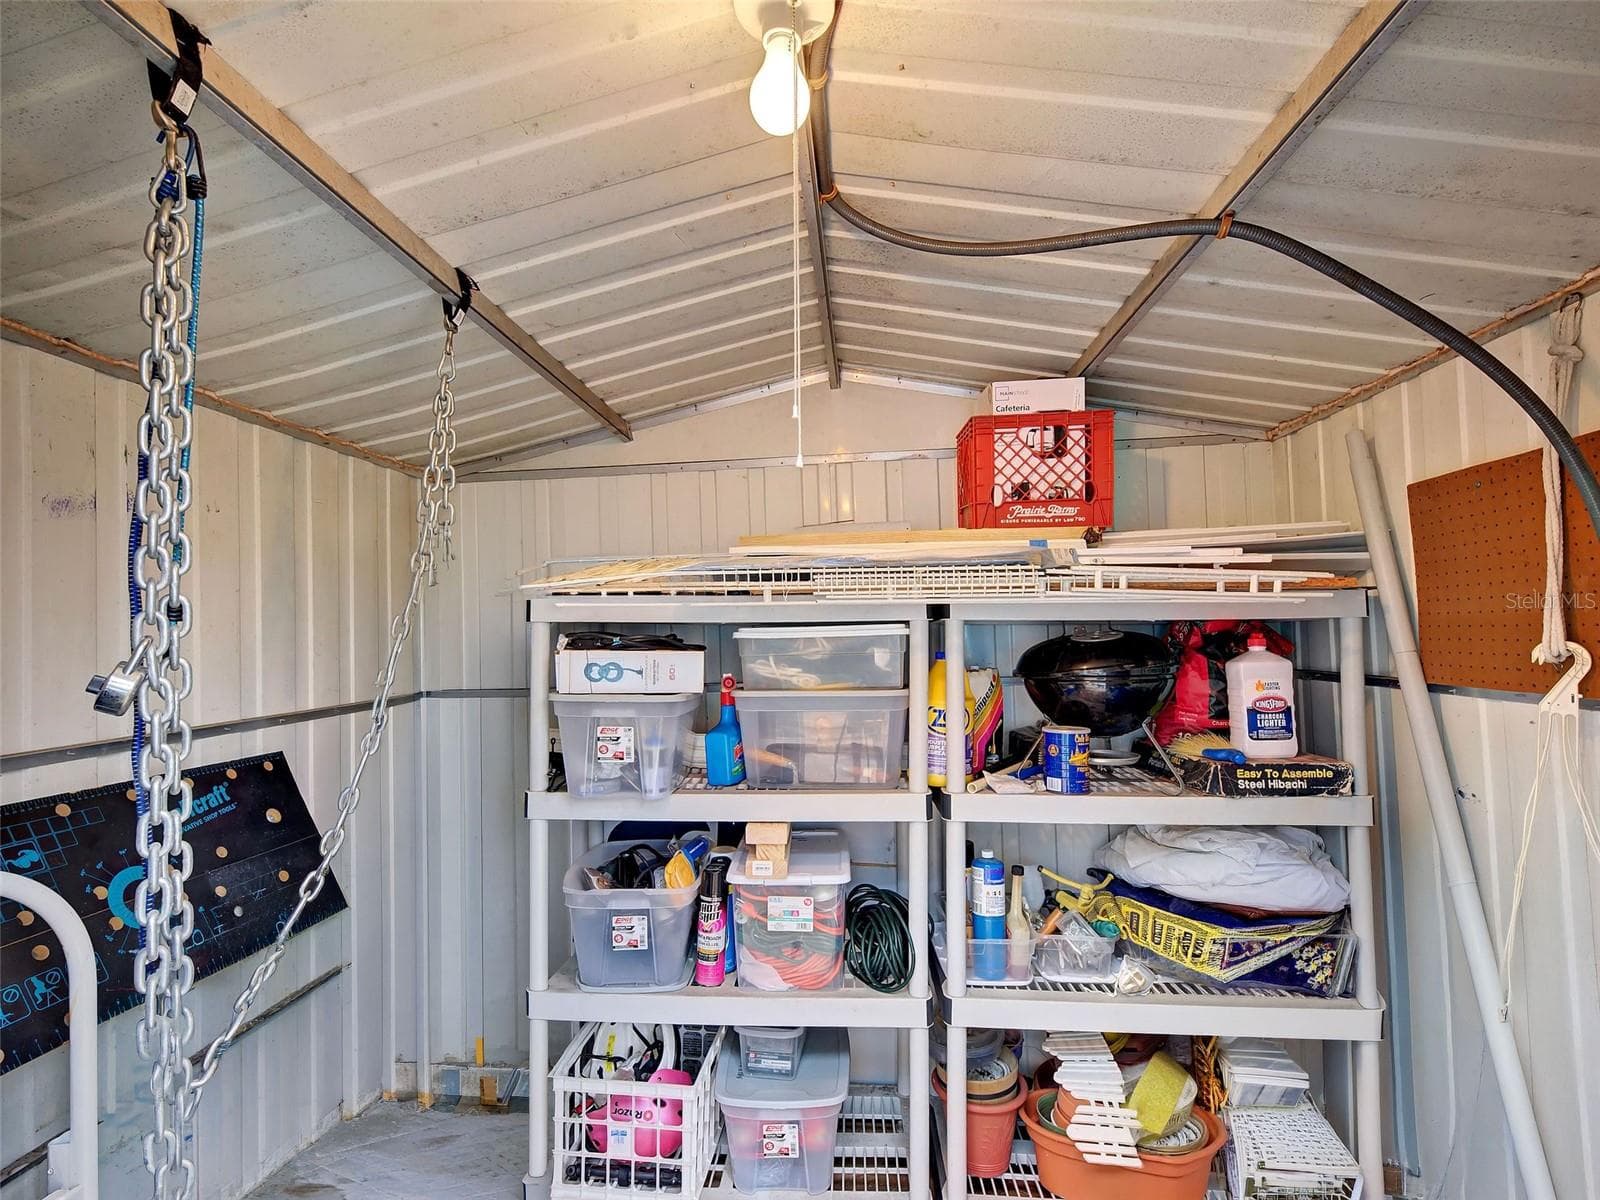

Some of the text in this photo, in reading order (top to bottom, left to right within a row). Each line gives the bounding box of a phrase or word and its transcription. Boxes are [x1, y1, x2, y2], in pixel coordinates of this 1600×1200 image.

[995, 404, 1031, 413] Cafeteria
[1007, 504, 1081, 519] Prairie Farms
[1255, 699, 1286, 709] KINGSFORD
[1257, 719, 1287, 728] LIGHTER
[1236, 768, 1334, 779] Easy To Assemble
[1237, 780, 1308, 789] Steel Hibachi
[203, 811, 219, 823] SHOP
[218, 802, 237, 816] TOOLS
[701, 903, 720, 913] HOT
[699, 911, 722, 923] SHOT
